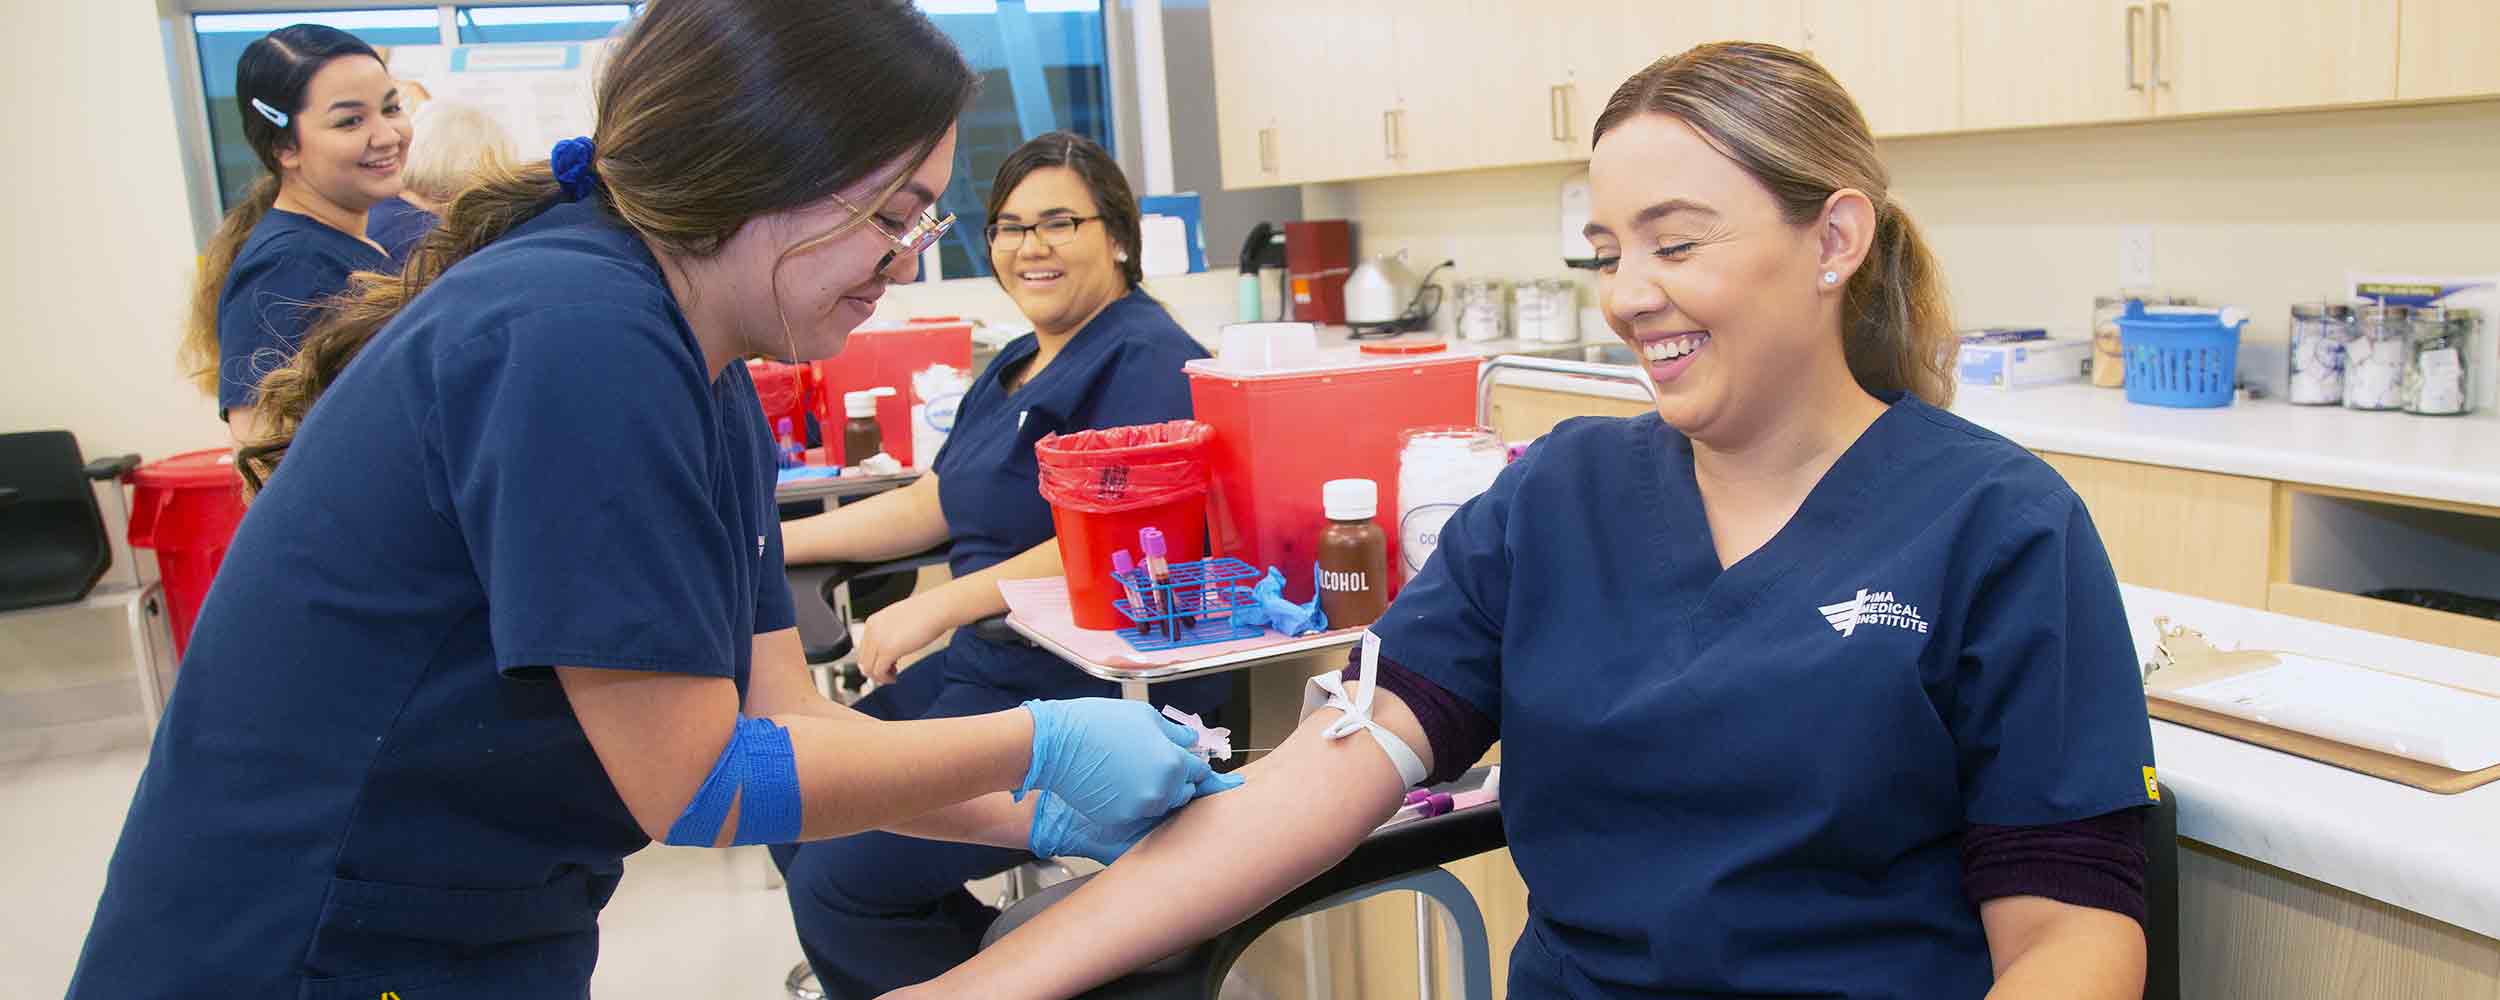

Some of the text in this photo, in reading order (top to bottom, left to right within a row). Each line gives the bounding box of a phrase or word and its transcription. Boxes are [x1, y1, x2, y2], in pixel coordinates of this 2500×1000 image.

[1319, 568, 1369, 592] LCOHOL
[1863, 591, 1895, 603] PIMA
[1861, 602, 1921, 619] MEDICAL
[1856, 613, 1929, 633] INSTITUTE
